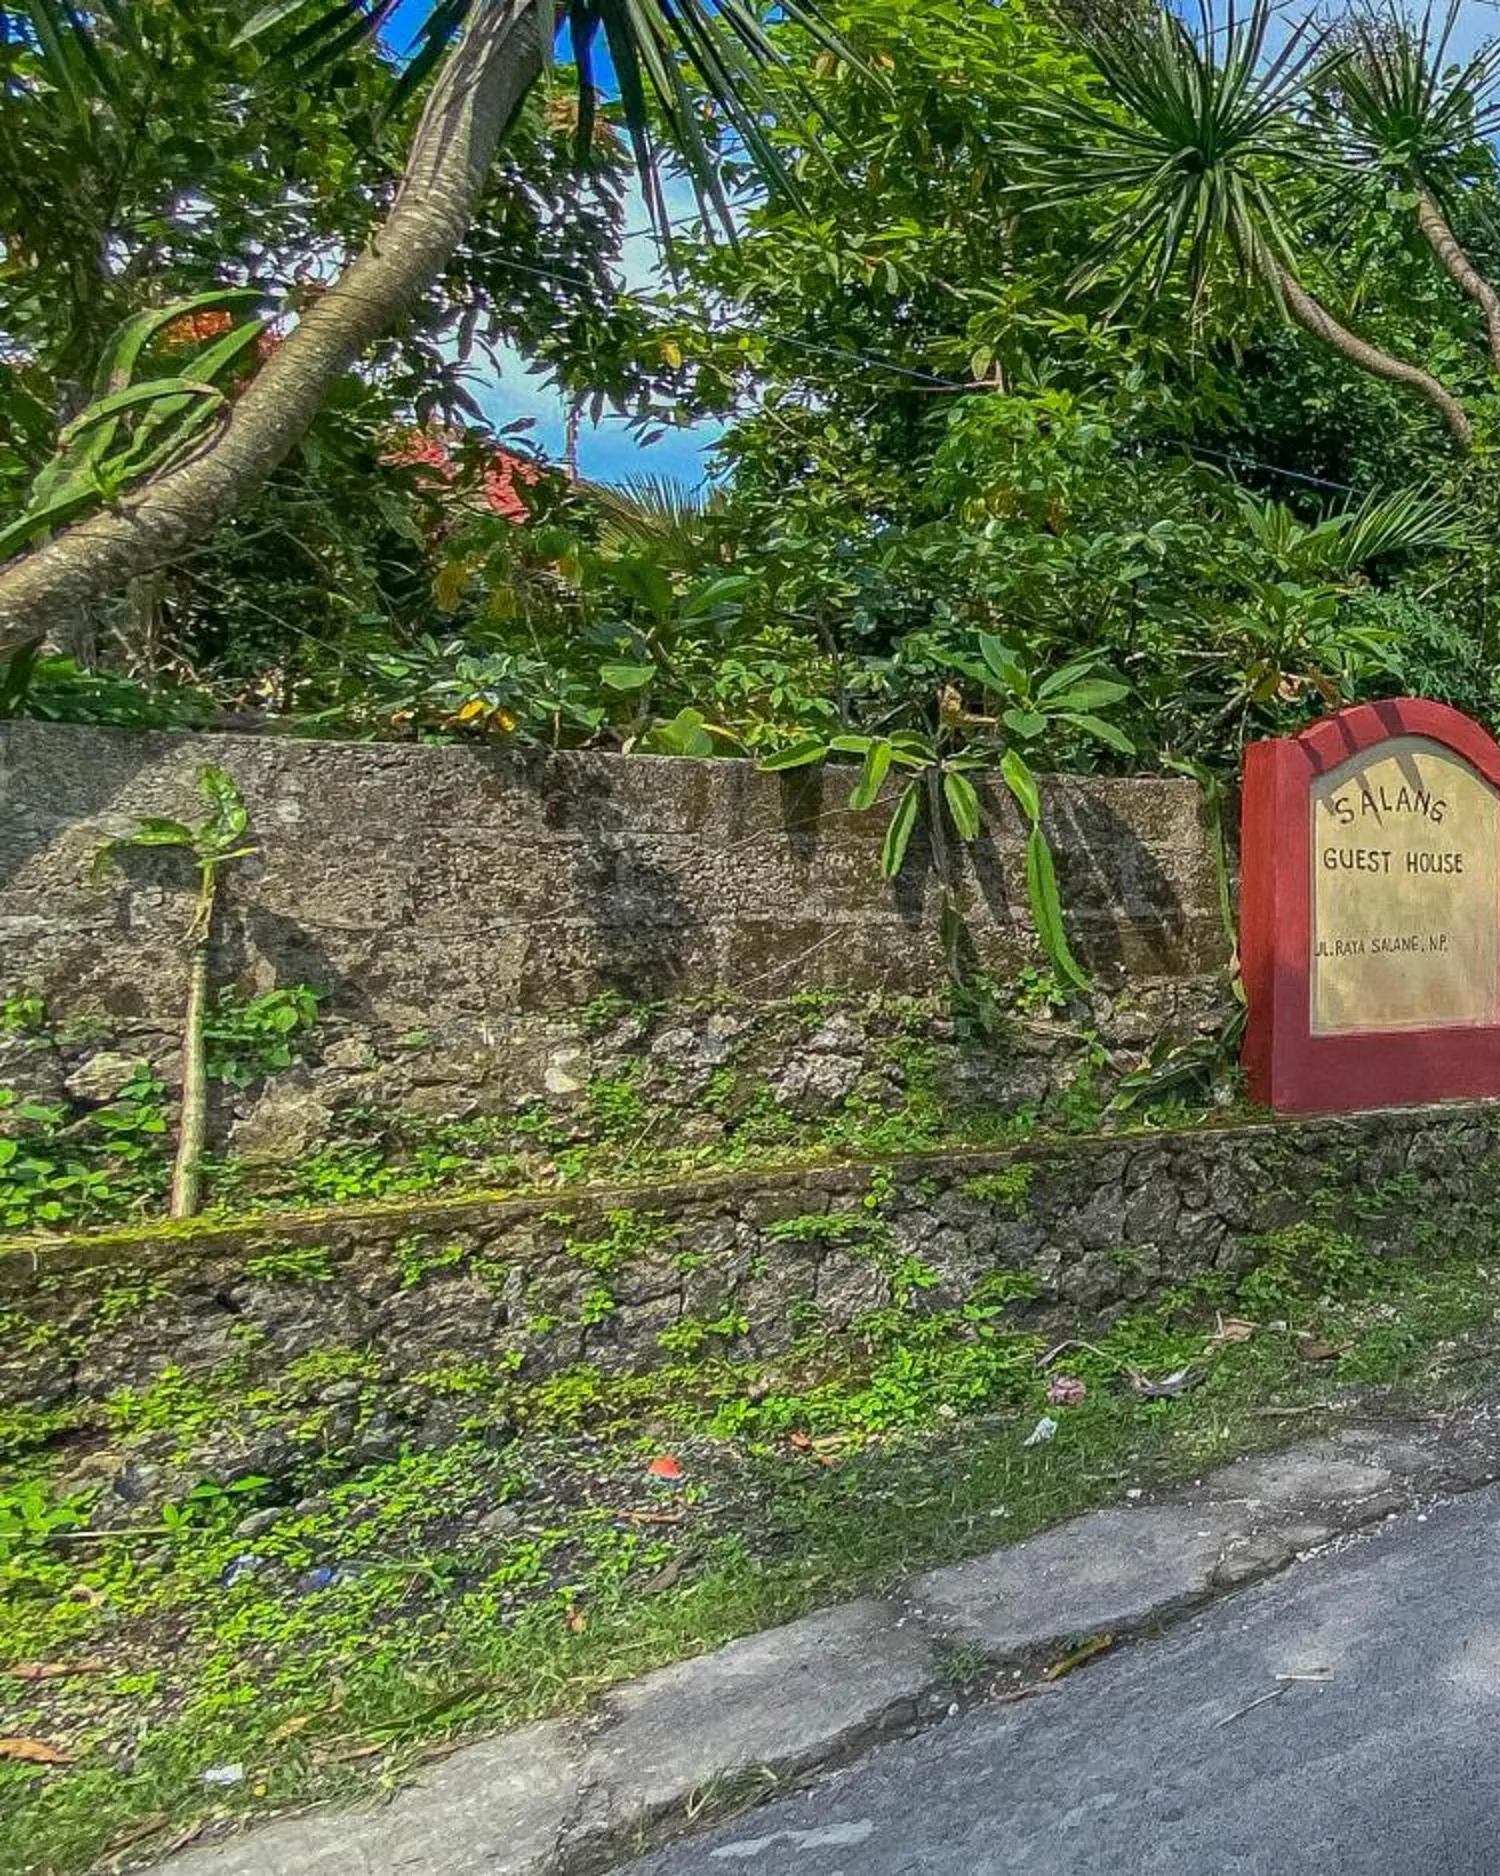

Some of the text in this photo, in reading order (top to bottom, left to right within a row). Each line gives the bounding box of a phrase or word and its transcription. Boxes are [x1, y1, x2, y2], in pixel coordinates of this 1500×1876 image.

[1335, 786, 1447, 824] SALANG
[1323, 847, 1463, 874] GUEST HOUSE
